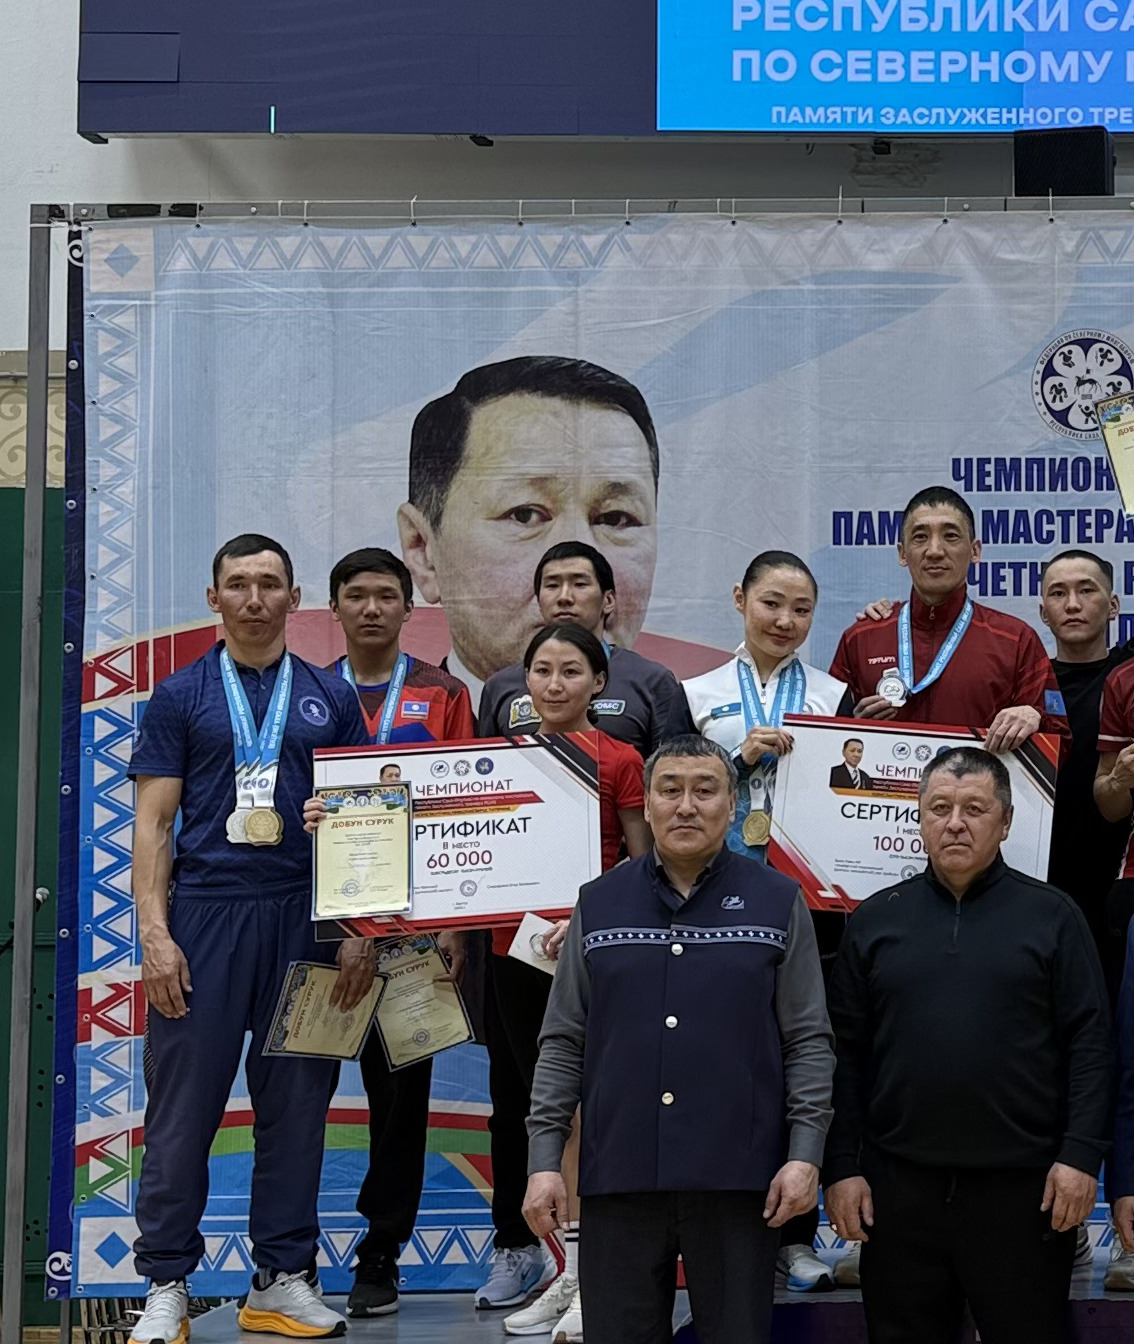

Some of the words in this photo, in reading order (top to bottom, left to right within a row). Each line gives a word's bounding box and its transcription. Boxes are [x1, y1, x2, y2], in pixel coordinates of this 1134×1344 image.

[732, 50, 798, 83] ПО
[811, 50, 1111, 84] СЕВЕРНОМУ
[771, 105, 874, 125] ПАМЯТИ
[879, 106, 1084, 126] ЗАСЛУЖЕННОГО
[952, 456, 1118, 494] ЧЕМПИОН
[832, 511, 905, 547] ПАМ
[415, 778, 514, 797] ЧЕМПИОНАТ
[365, 817, 395, 827] СУРУК
[414, 816, 533, 841] РТИФИКАТ
[873, 835, 905, 853] 100
[426, 852, 450, 870] 60
[455, 849, 494, 867] 000
